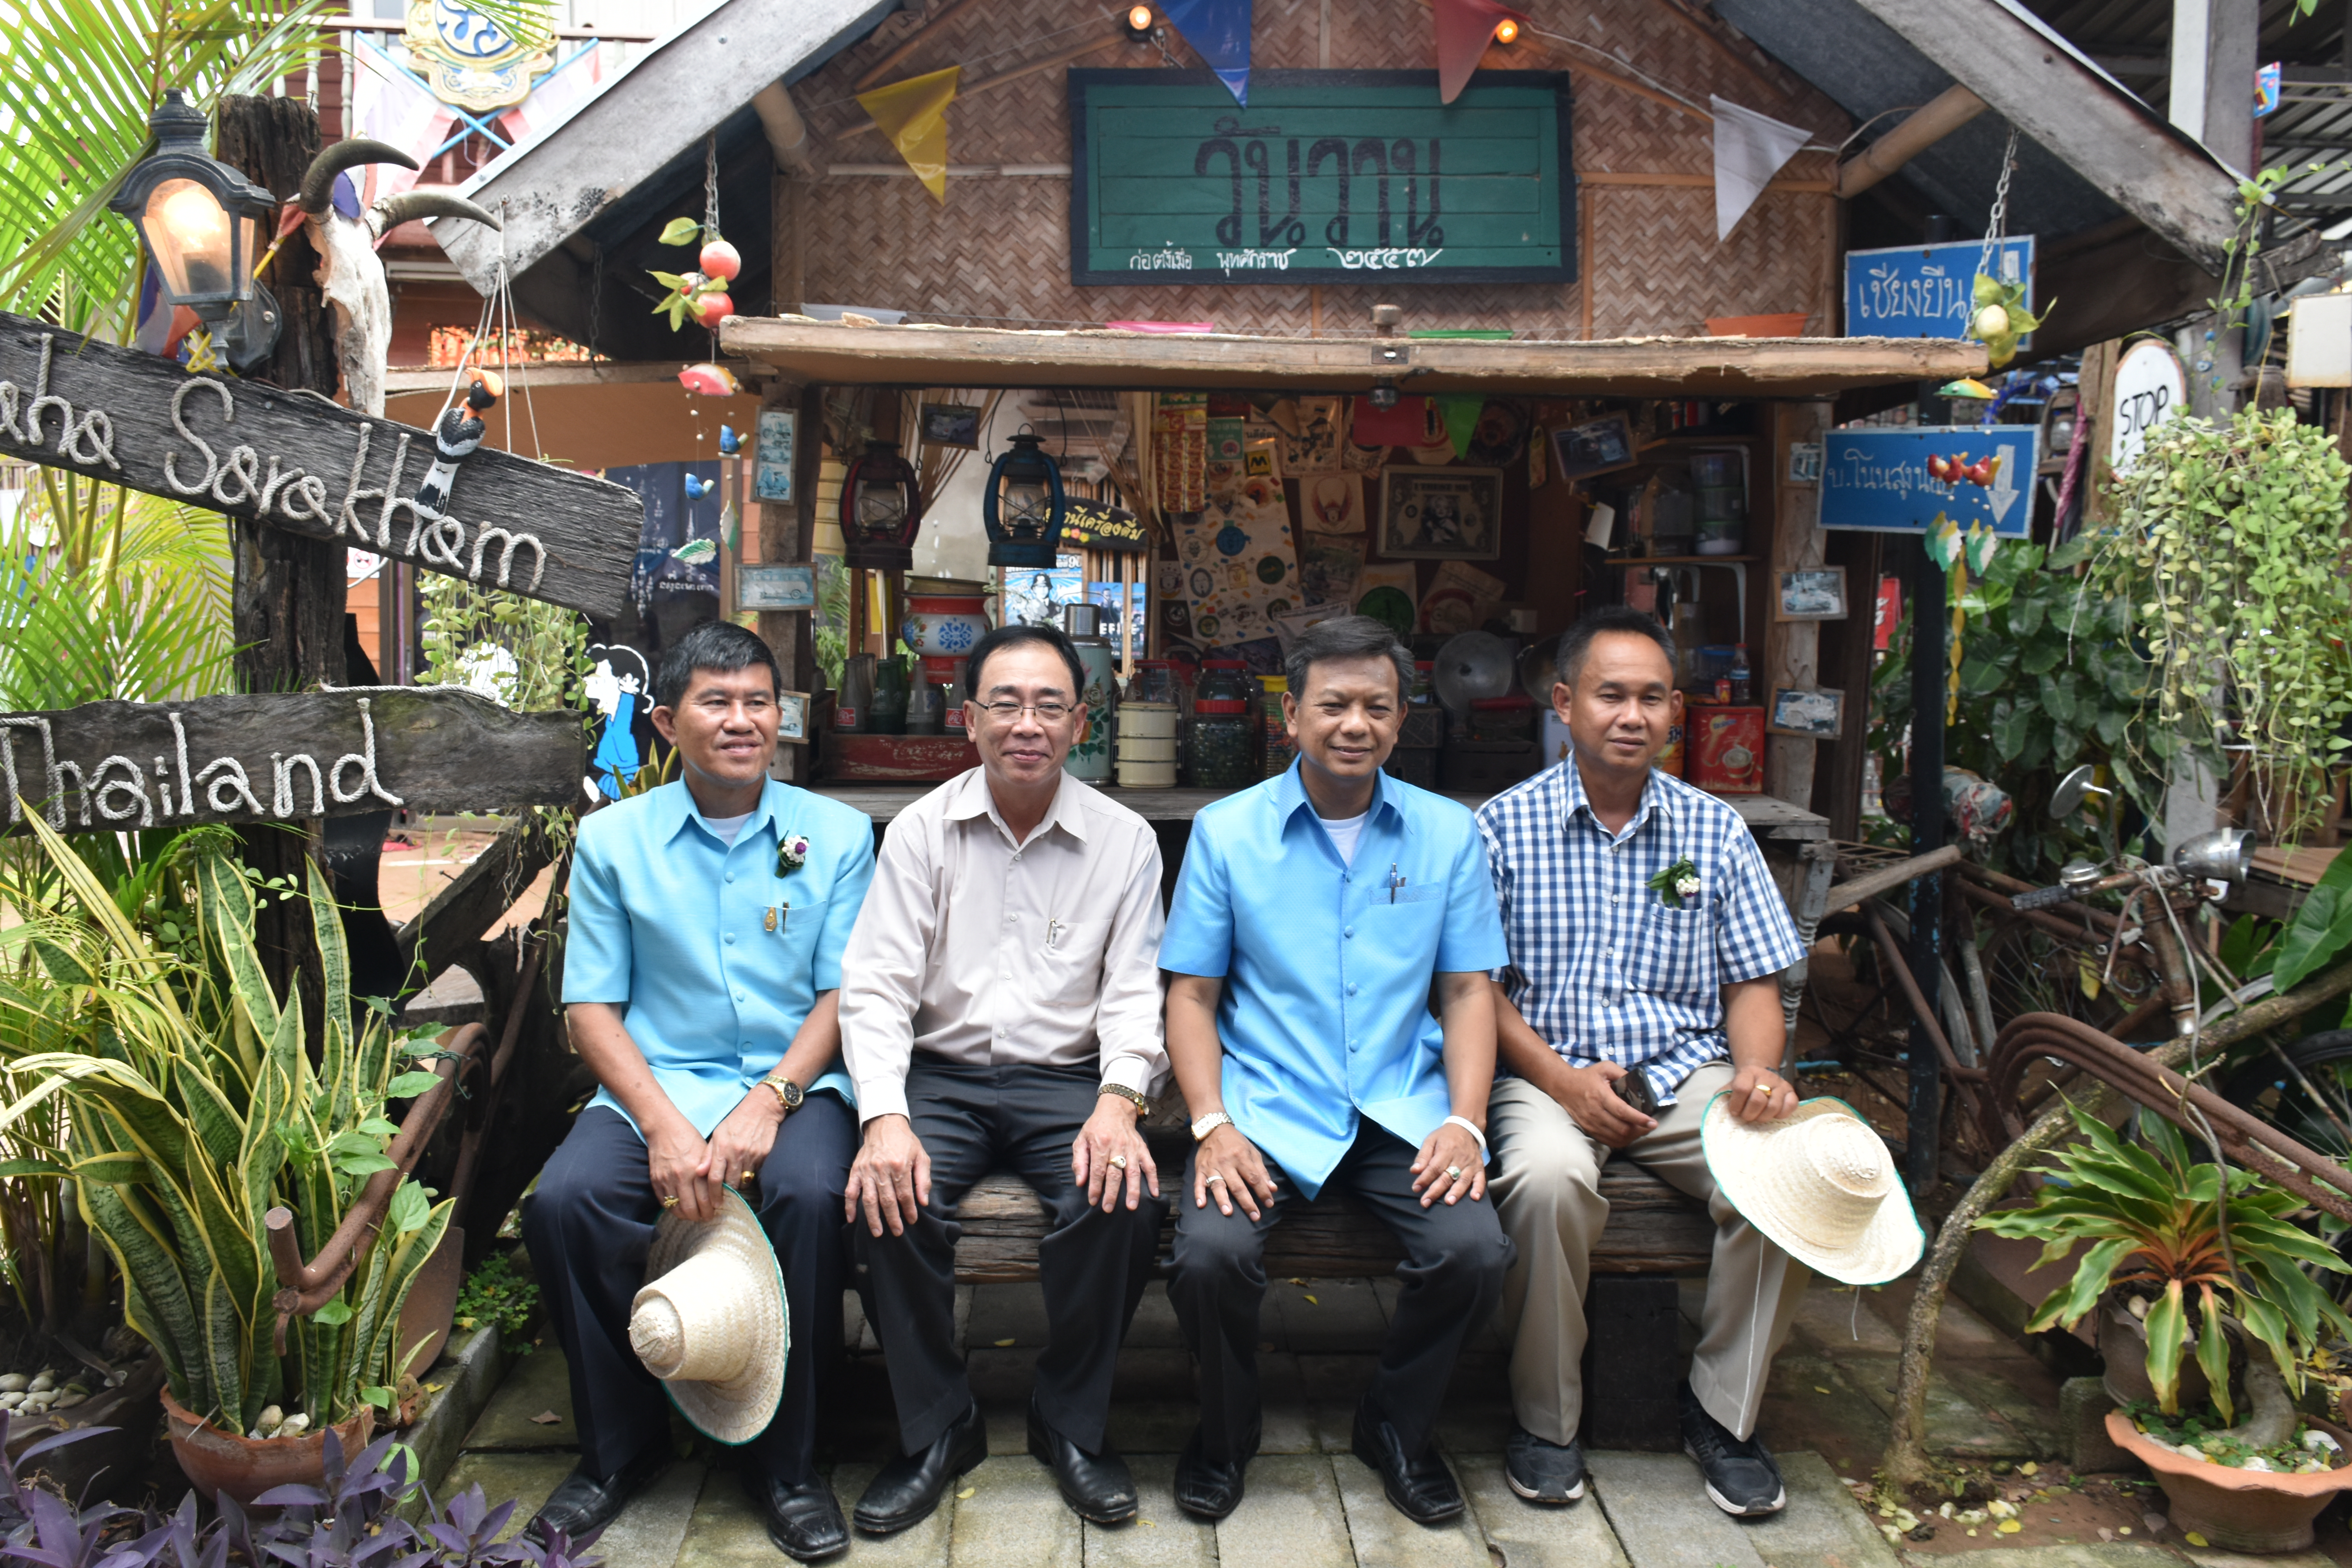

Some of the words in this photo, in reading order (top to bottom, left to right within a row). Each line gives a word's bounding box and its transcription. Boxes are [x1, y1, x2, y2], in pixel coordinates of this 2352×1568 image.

[1194, 116, 1444, 248] วันวาน
[1327, 247, 1443, 269] ๒๕๕๗
[1859, 262, 1967, 319] เชียงยืน
[2120, 385, 2169, 436] STOP
[0, 697, 404, 831] Thailand
